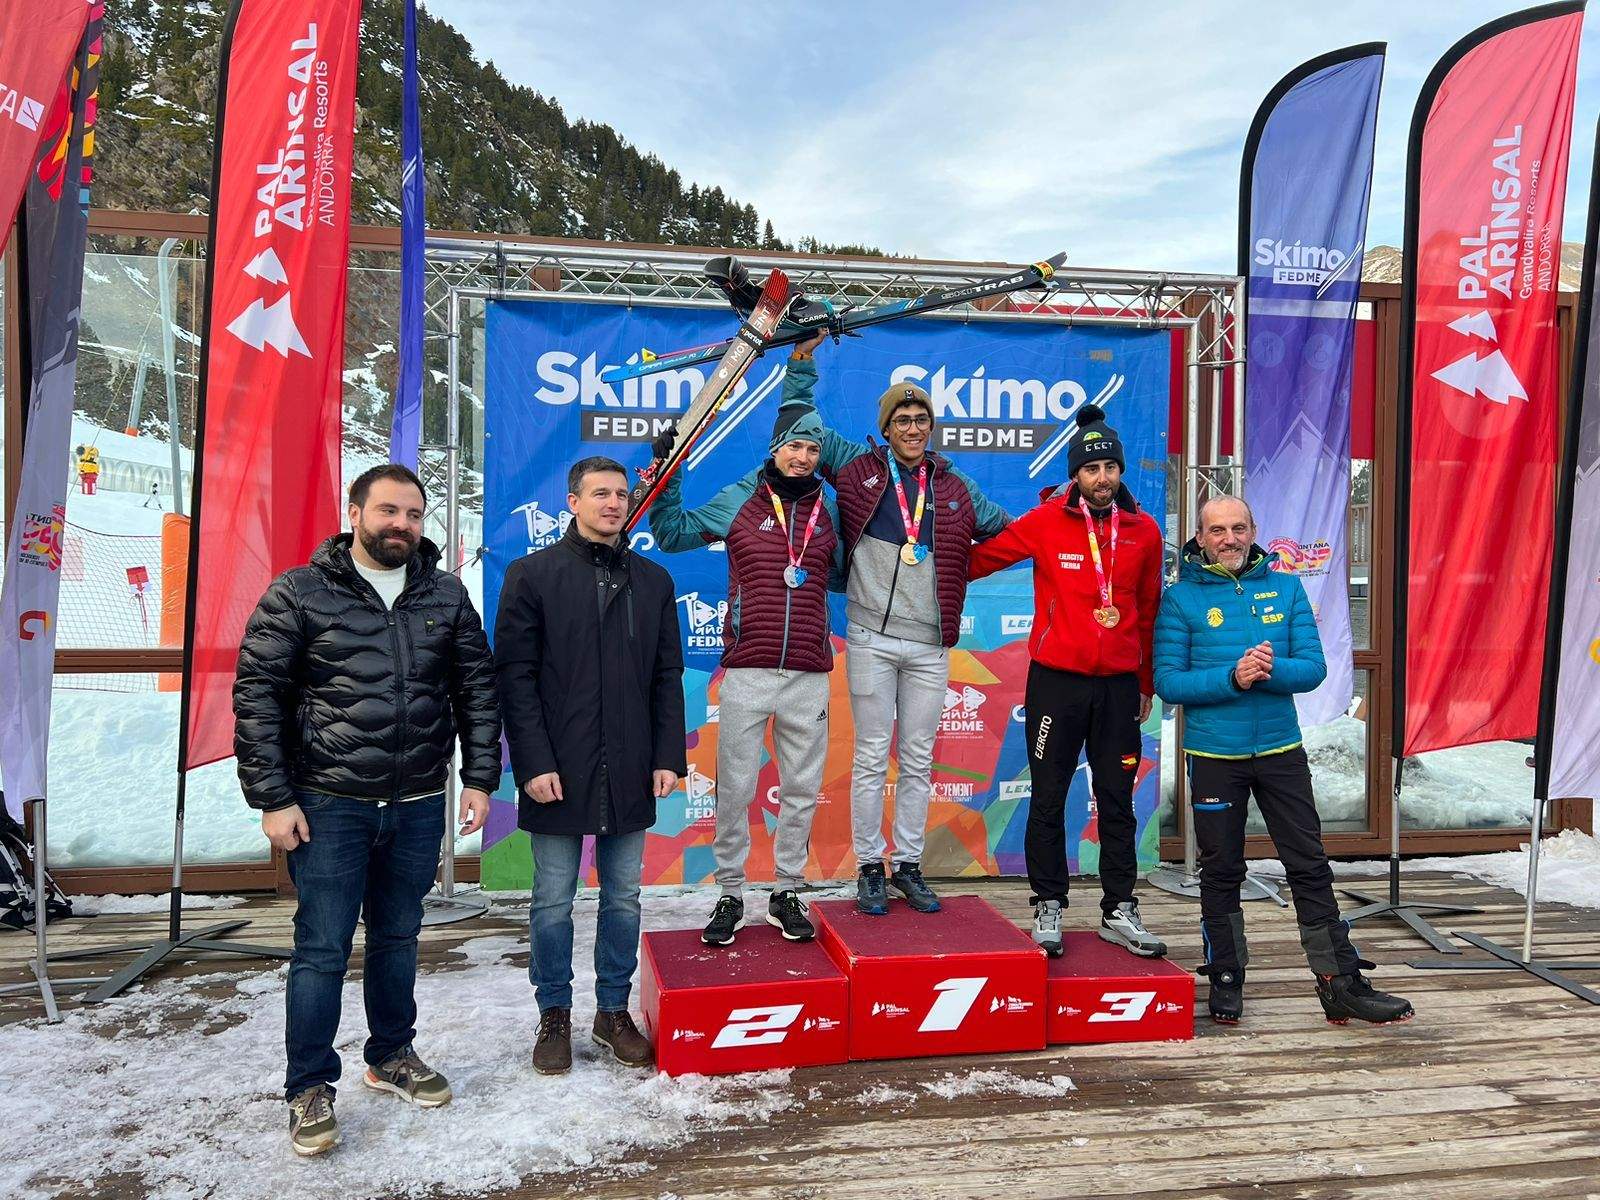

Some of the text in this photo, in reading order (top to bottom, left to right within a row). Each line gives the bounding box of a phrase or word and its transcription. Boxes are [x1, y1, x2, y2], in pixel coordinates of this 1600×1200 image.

[312, 60, 329, 129] Resorts
[274, 22, 317, 231] ARINSAL
[253, 148, 286, 239] PAL
[318, 134, 336, 227] ANDORRA
[1489, 124, 1523, 301] ARINSAL
[1279, 271, 1321, 283] FEDME
[1457, 224, 1489, 300] PAL
[1519, 218, 1536, 300] Grandvalira
[1537, 220, 1553, 292] ANDORRA
[798, 313, 829, 324] SCARPA
[533, 350, 748, 412] Skim
[593, 415, 681, 437] FEDM
[942, 427, 1035, 448] FEDME
[1060, 561, 1081, 570] TIERRA
[687, 635, 725, 647] FEDM
[695, 624, 724, 636] año
[1262, 612, 1284, 624] ESP
[1034, 715, 1053, 760] EJERCITO
[710, 1003, 804, 1049] 2
[917, 976, 989, 1032] 1
[1087, 991, 1157, 1023] 3
